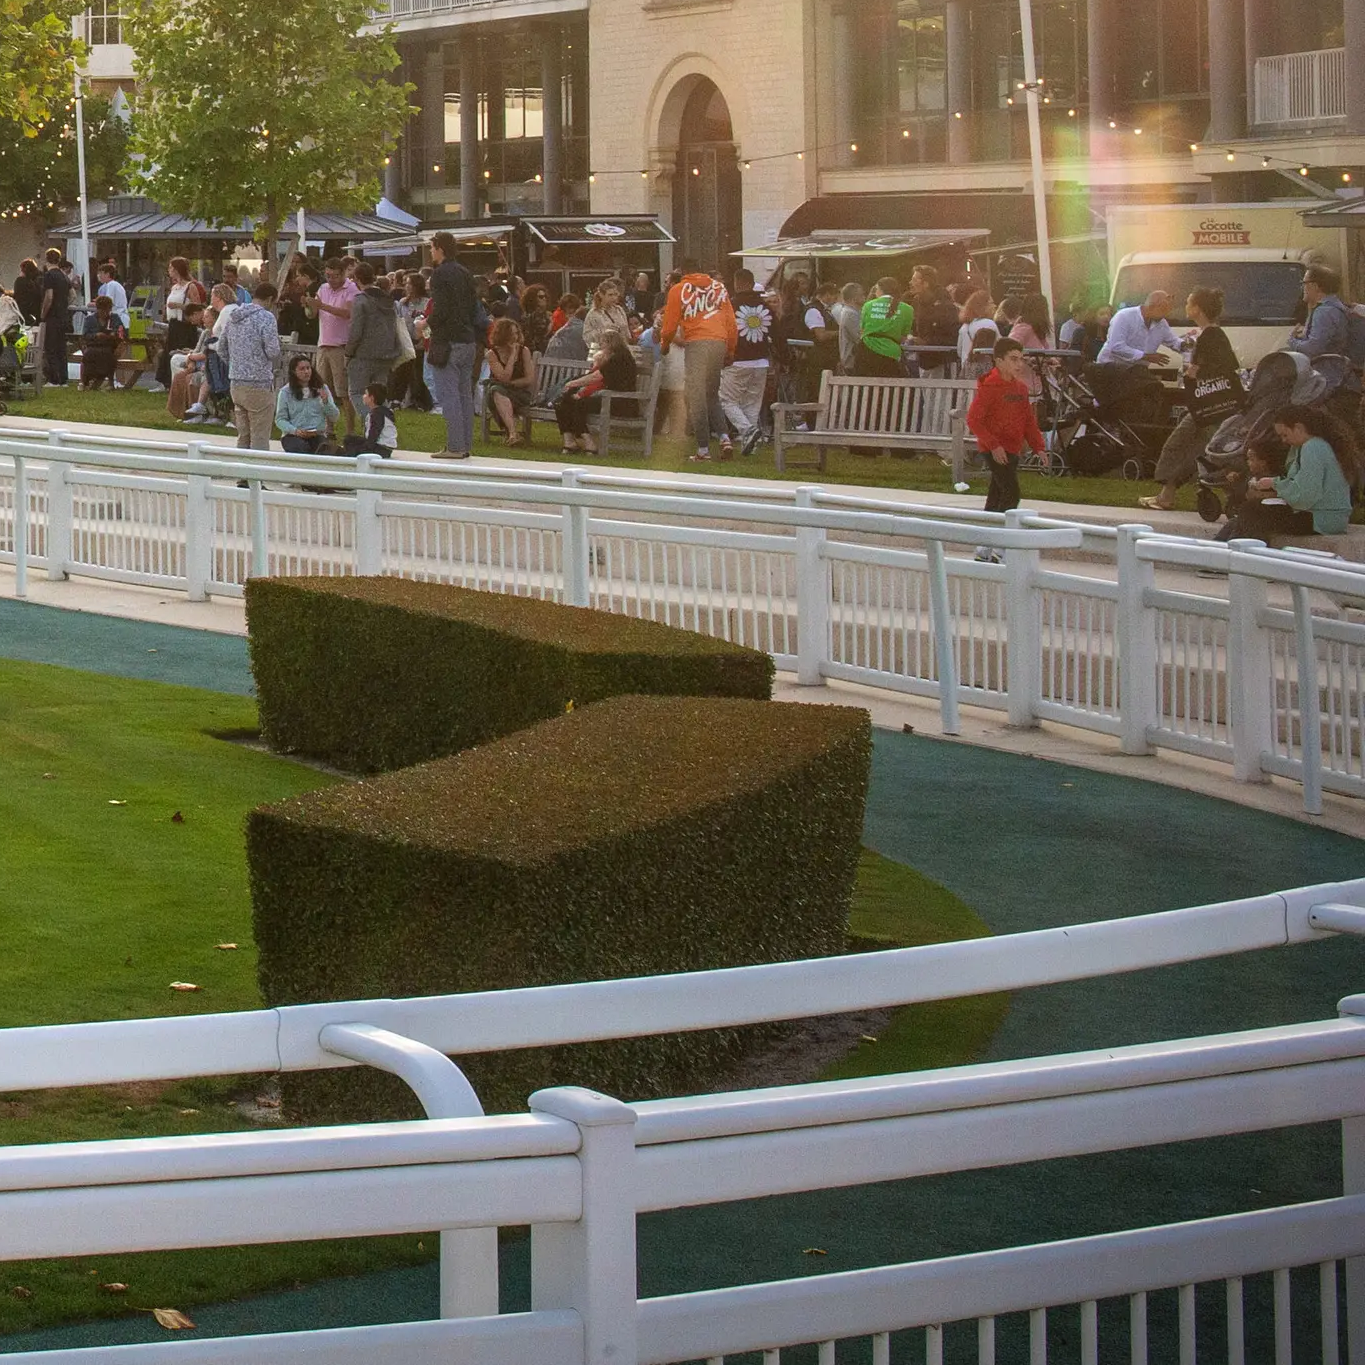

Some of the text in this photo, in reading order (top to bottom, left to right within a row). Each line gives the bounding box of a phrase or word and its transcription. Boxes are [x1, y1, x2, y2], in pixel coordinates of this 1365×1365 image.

[1200, 222, 1243, 230] Cocotte
[1199, 234, 1243, 244] MOBILE
[1195, 379, 1231, 398] ORGANIC
